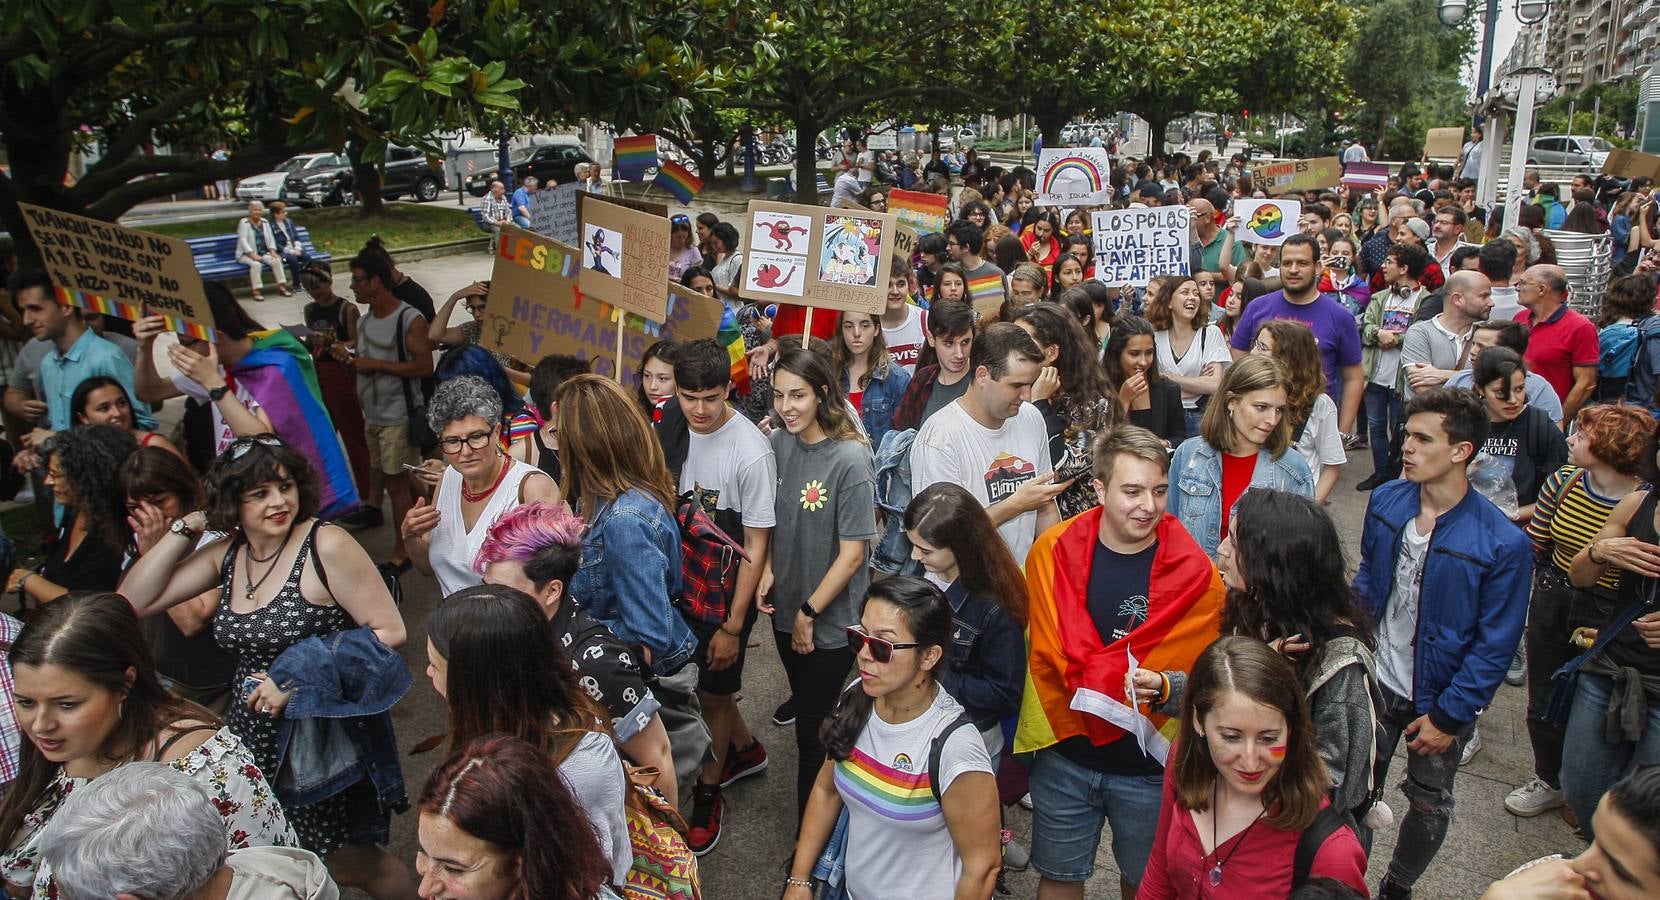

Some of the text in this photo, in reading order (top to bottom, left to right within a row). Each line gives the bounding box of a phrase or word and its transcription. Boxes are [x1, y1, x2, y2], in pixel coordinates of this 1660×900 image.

[1253, 161, 1308, 180] EL AMOR ES
[1049, 192, 1064, 201] POR
[1097, 208, 1188, 232] LOS POLOS
[150, 238, 172, 256] NO
[44, 247, 57, 265] A
[73, 251, 96, 272] EL
[159, 275, 180, 292] NO
[75, 273, 110, 292] HIZO
[572, 283, 586, 310] Y
[528, 331, 544, 354] Y
[1508, 438, 1518, 447] IS
